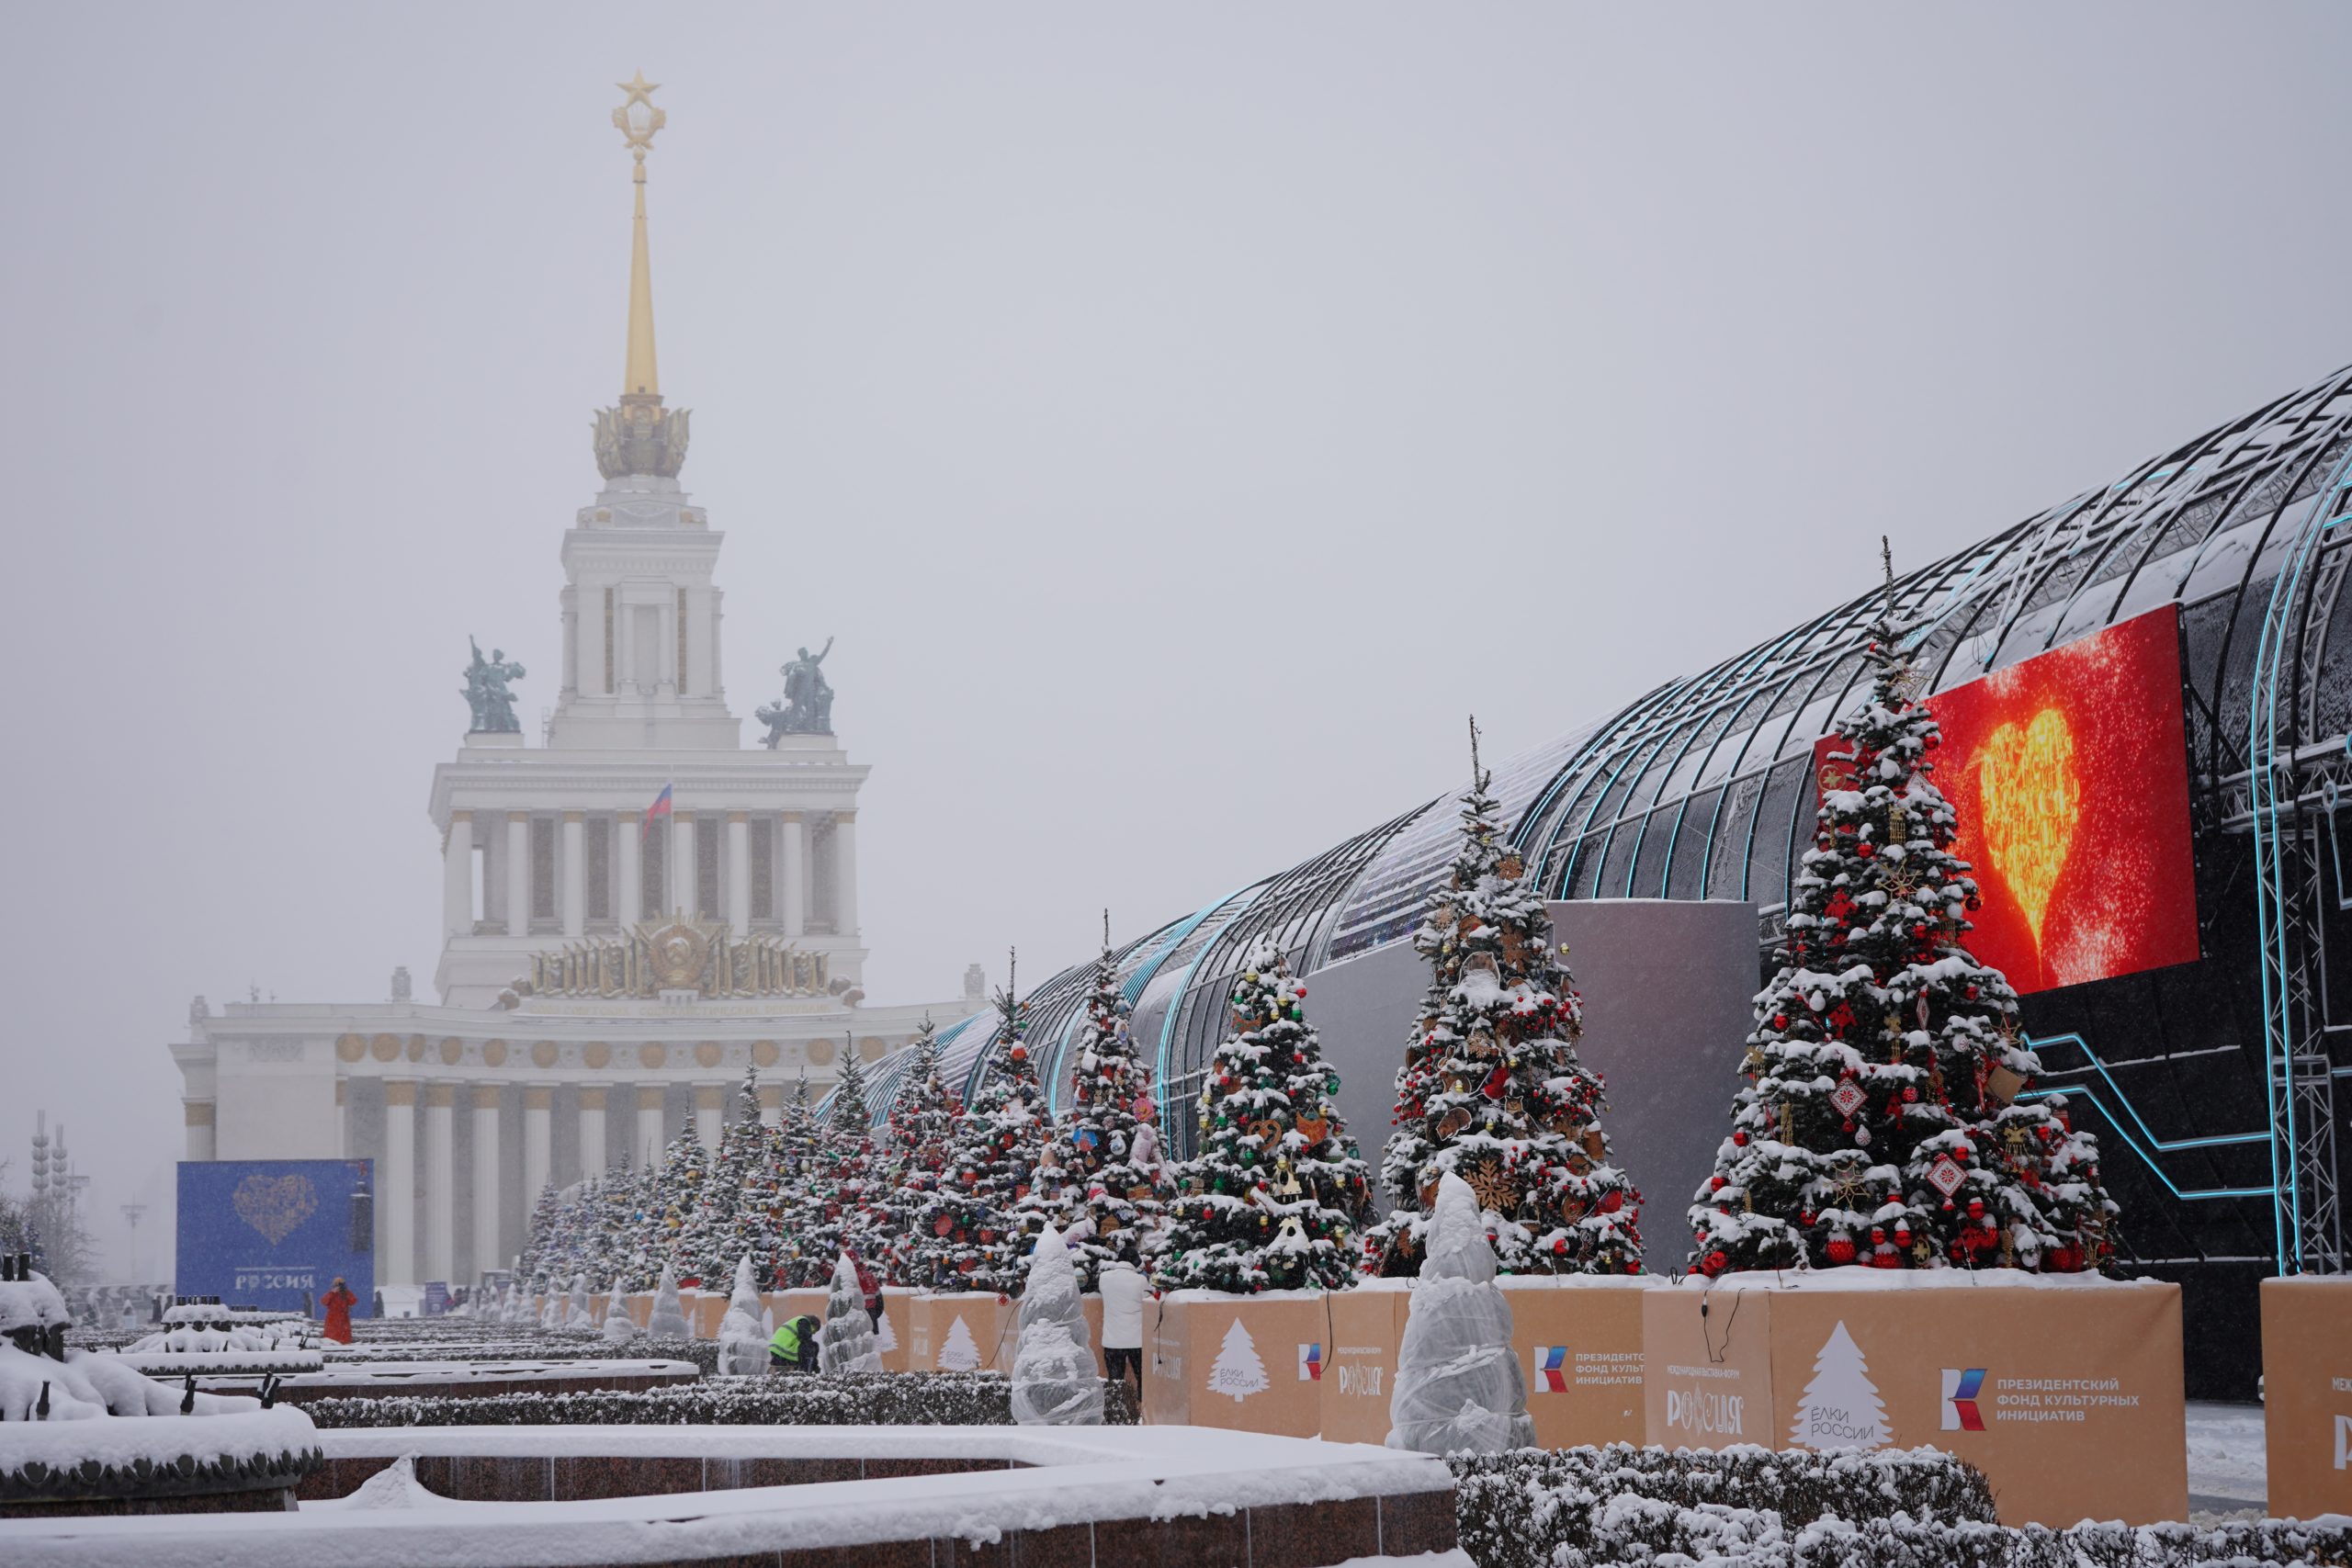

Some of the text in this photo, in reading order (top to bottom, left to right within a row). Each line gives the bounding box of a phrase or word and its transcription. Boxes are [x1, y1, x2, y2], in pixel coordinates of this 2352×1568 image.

[1576, 1353, 1645, 1362] ПРЕЗИДЕНТС
[1576, 1365, 1645, 1374] ФОНД КУЛЬТ
[1220, 1377, 1260, 1388] РОССИИ
[1576, 1376, 1643, 1385] ИНИЦИАТИВ
[1997, 1378, 2120, 1391] ПРЕЗИДЕНТСКИЙ
[1996, 1394, 2140, 1407] ФОНД КУЛЬТУРНЫХ
[1811, 1406, 1849, 1423] ЁЛКИ
[1996, 1410, 2086, 1422] ИНИЦИАТИВ
[1811, 1422, 1874, 1440] РОССИИ
